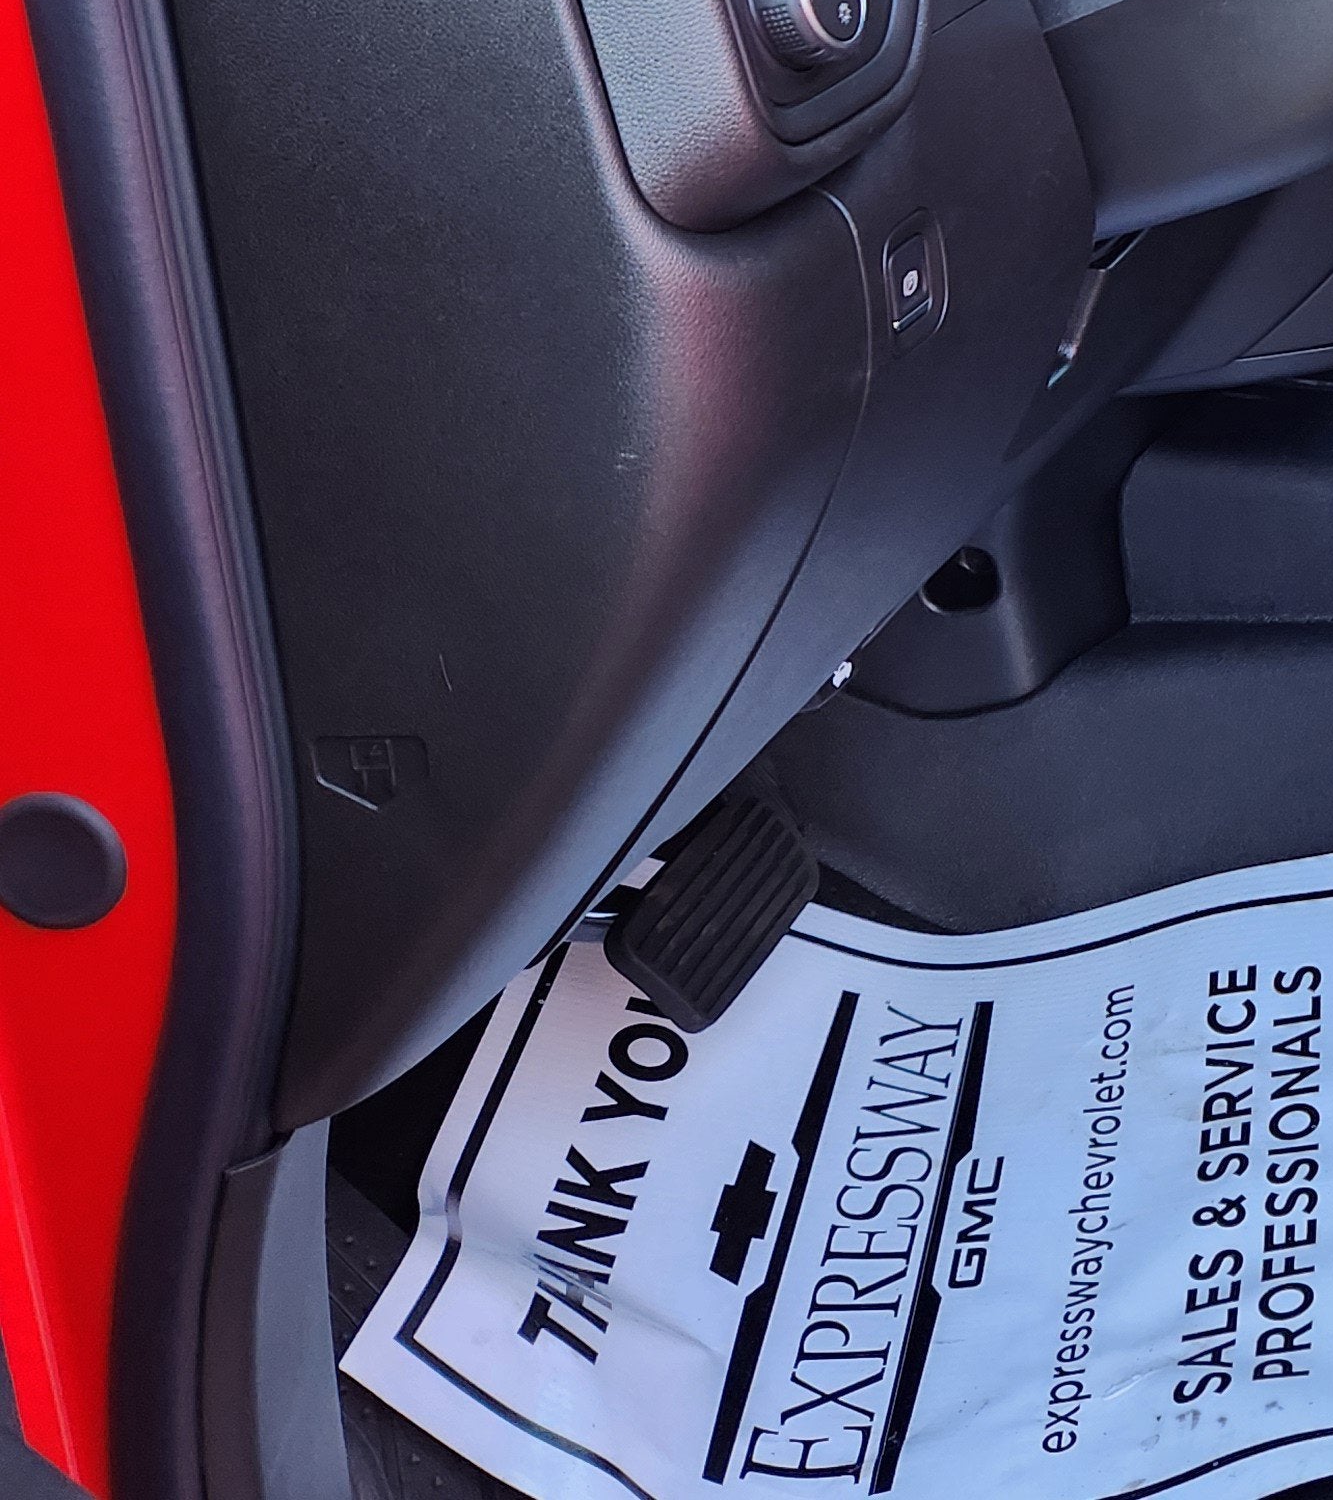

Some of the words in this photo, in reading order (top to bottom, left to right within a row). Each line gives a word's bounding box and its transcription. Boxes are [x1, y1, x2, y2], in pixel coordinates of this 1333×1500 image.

[1197, 964, 1257, 1183] SERVICE
[1252, 965, 1323, 1381] PROFESSIONALS
[517, 1144, 651, 1365] THANK
[739, 1004, 964, 1484] EXPRESSWAY
[948, 1155, 1004, 1289] GMC
[1042, 984, 1135, 1454] expresswaychevrolet.com
[1190, 1194, 1246, 1227] &
[1173, 1249, 1243, 1404] SALES
